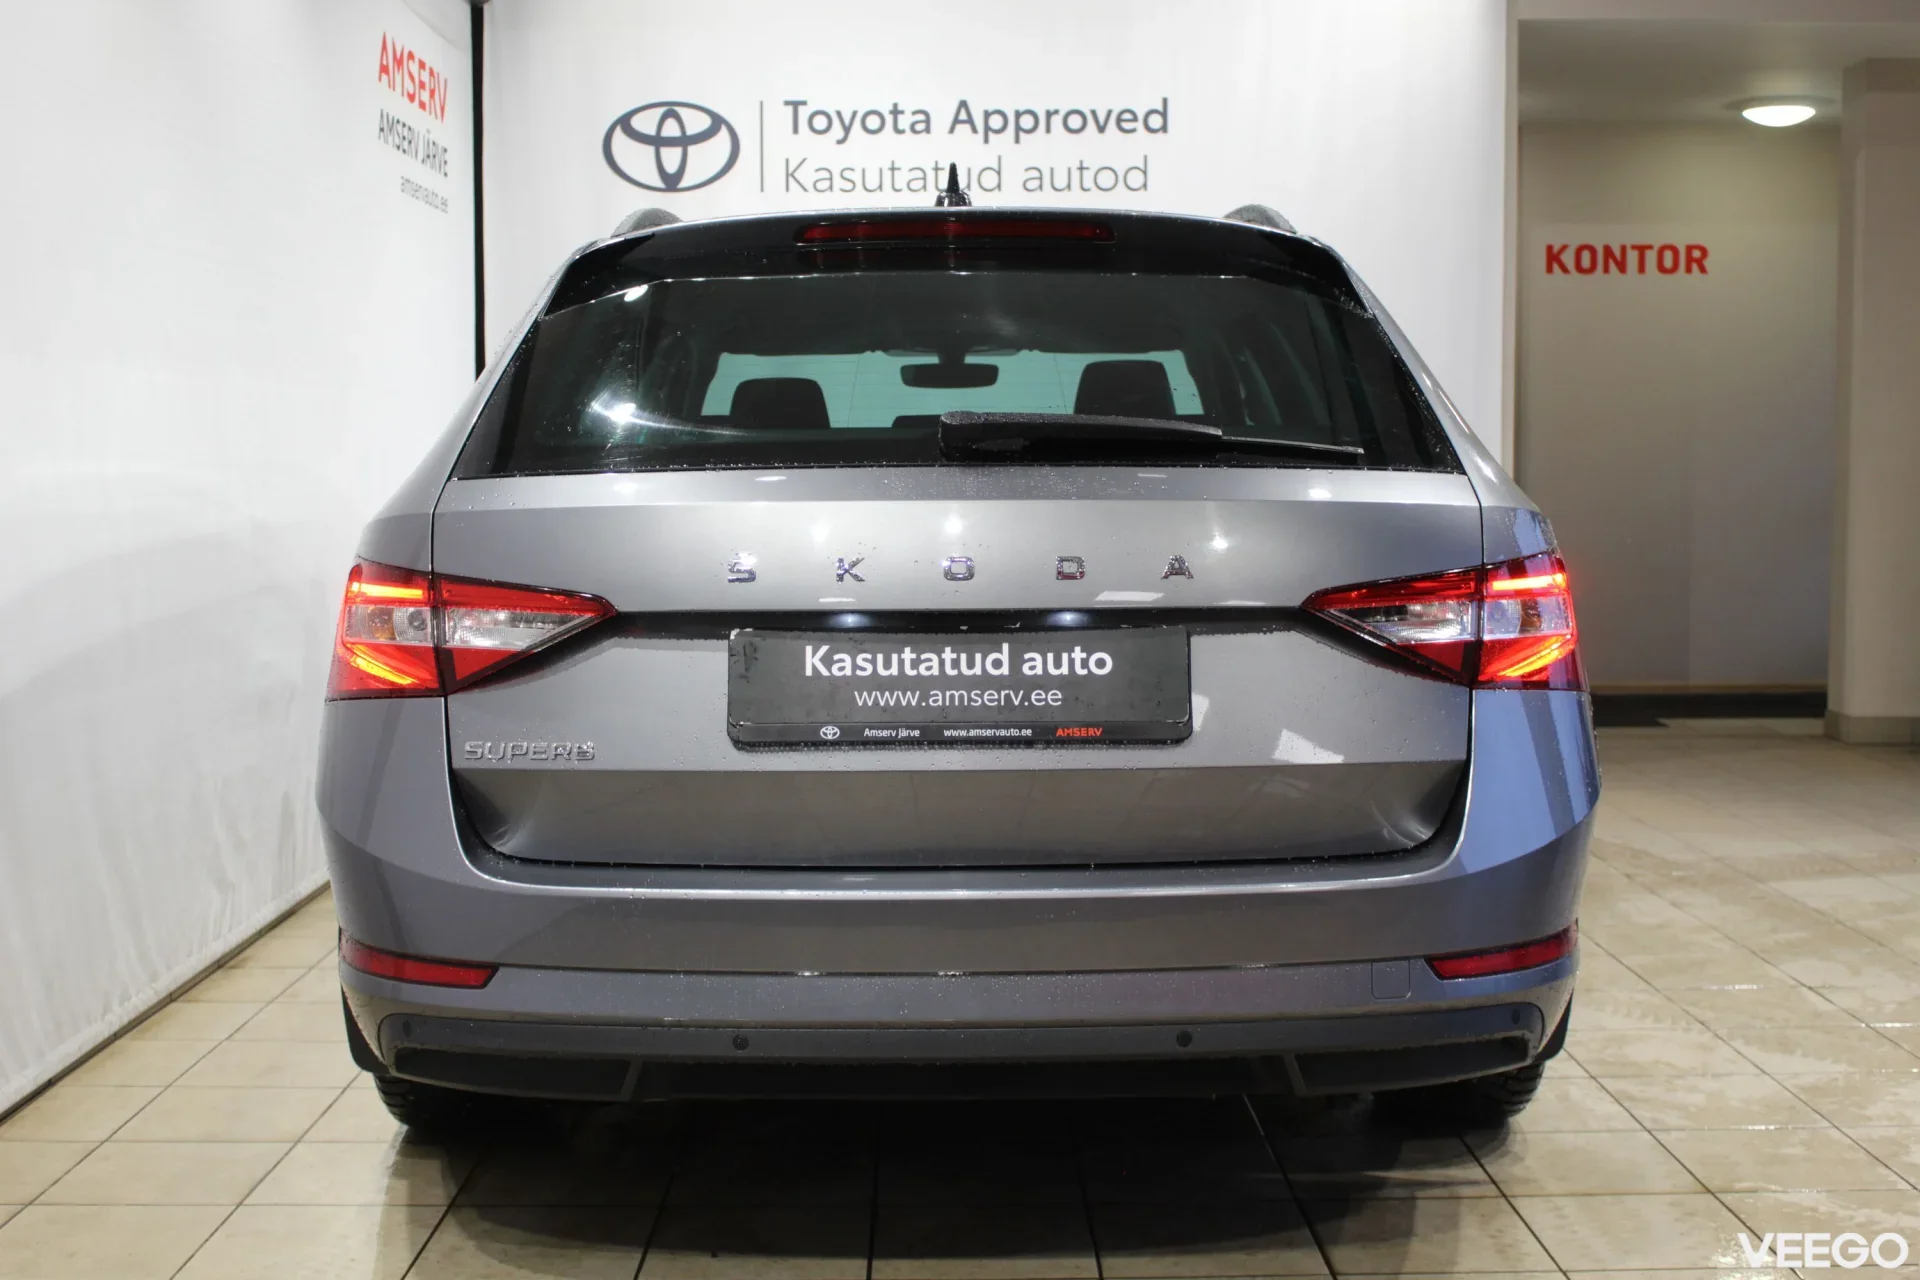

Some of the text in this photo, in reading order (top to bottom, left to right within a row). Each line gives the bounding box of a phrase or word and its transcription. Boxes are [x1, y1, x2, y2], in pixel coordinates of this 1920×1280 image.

[378, 31, 448, 124] AMSERV
[783, 97, 1170, 143] Toyota Approved
[378, 108, 448, 178] AMSERV JÄRVE
[1022, 155, 1148, 193] autod
[1545, 243, 1709, 275] KONTOR
[727, 554, 1194, 583] SKODA
[804, 644, 1114, 678] Kasutatud auto
[854, 687, 1063, 707] www.amserv.ee
[863, 727, 1103, 738] Amserv Järve www.amservauto.ee AMSERV
[464, 741, 595, 761] SUPERB
